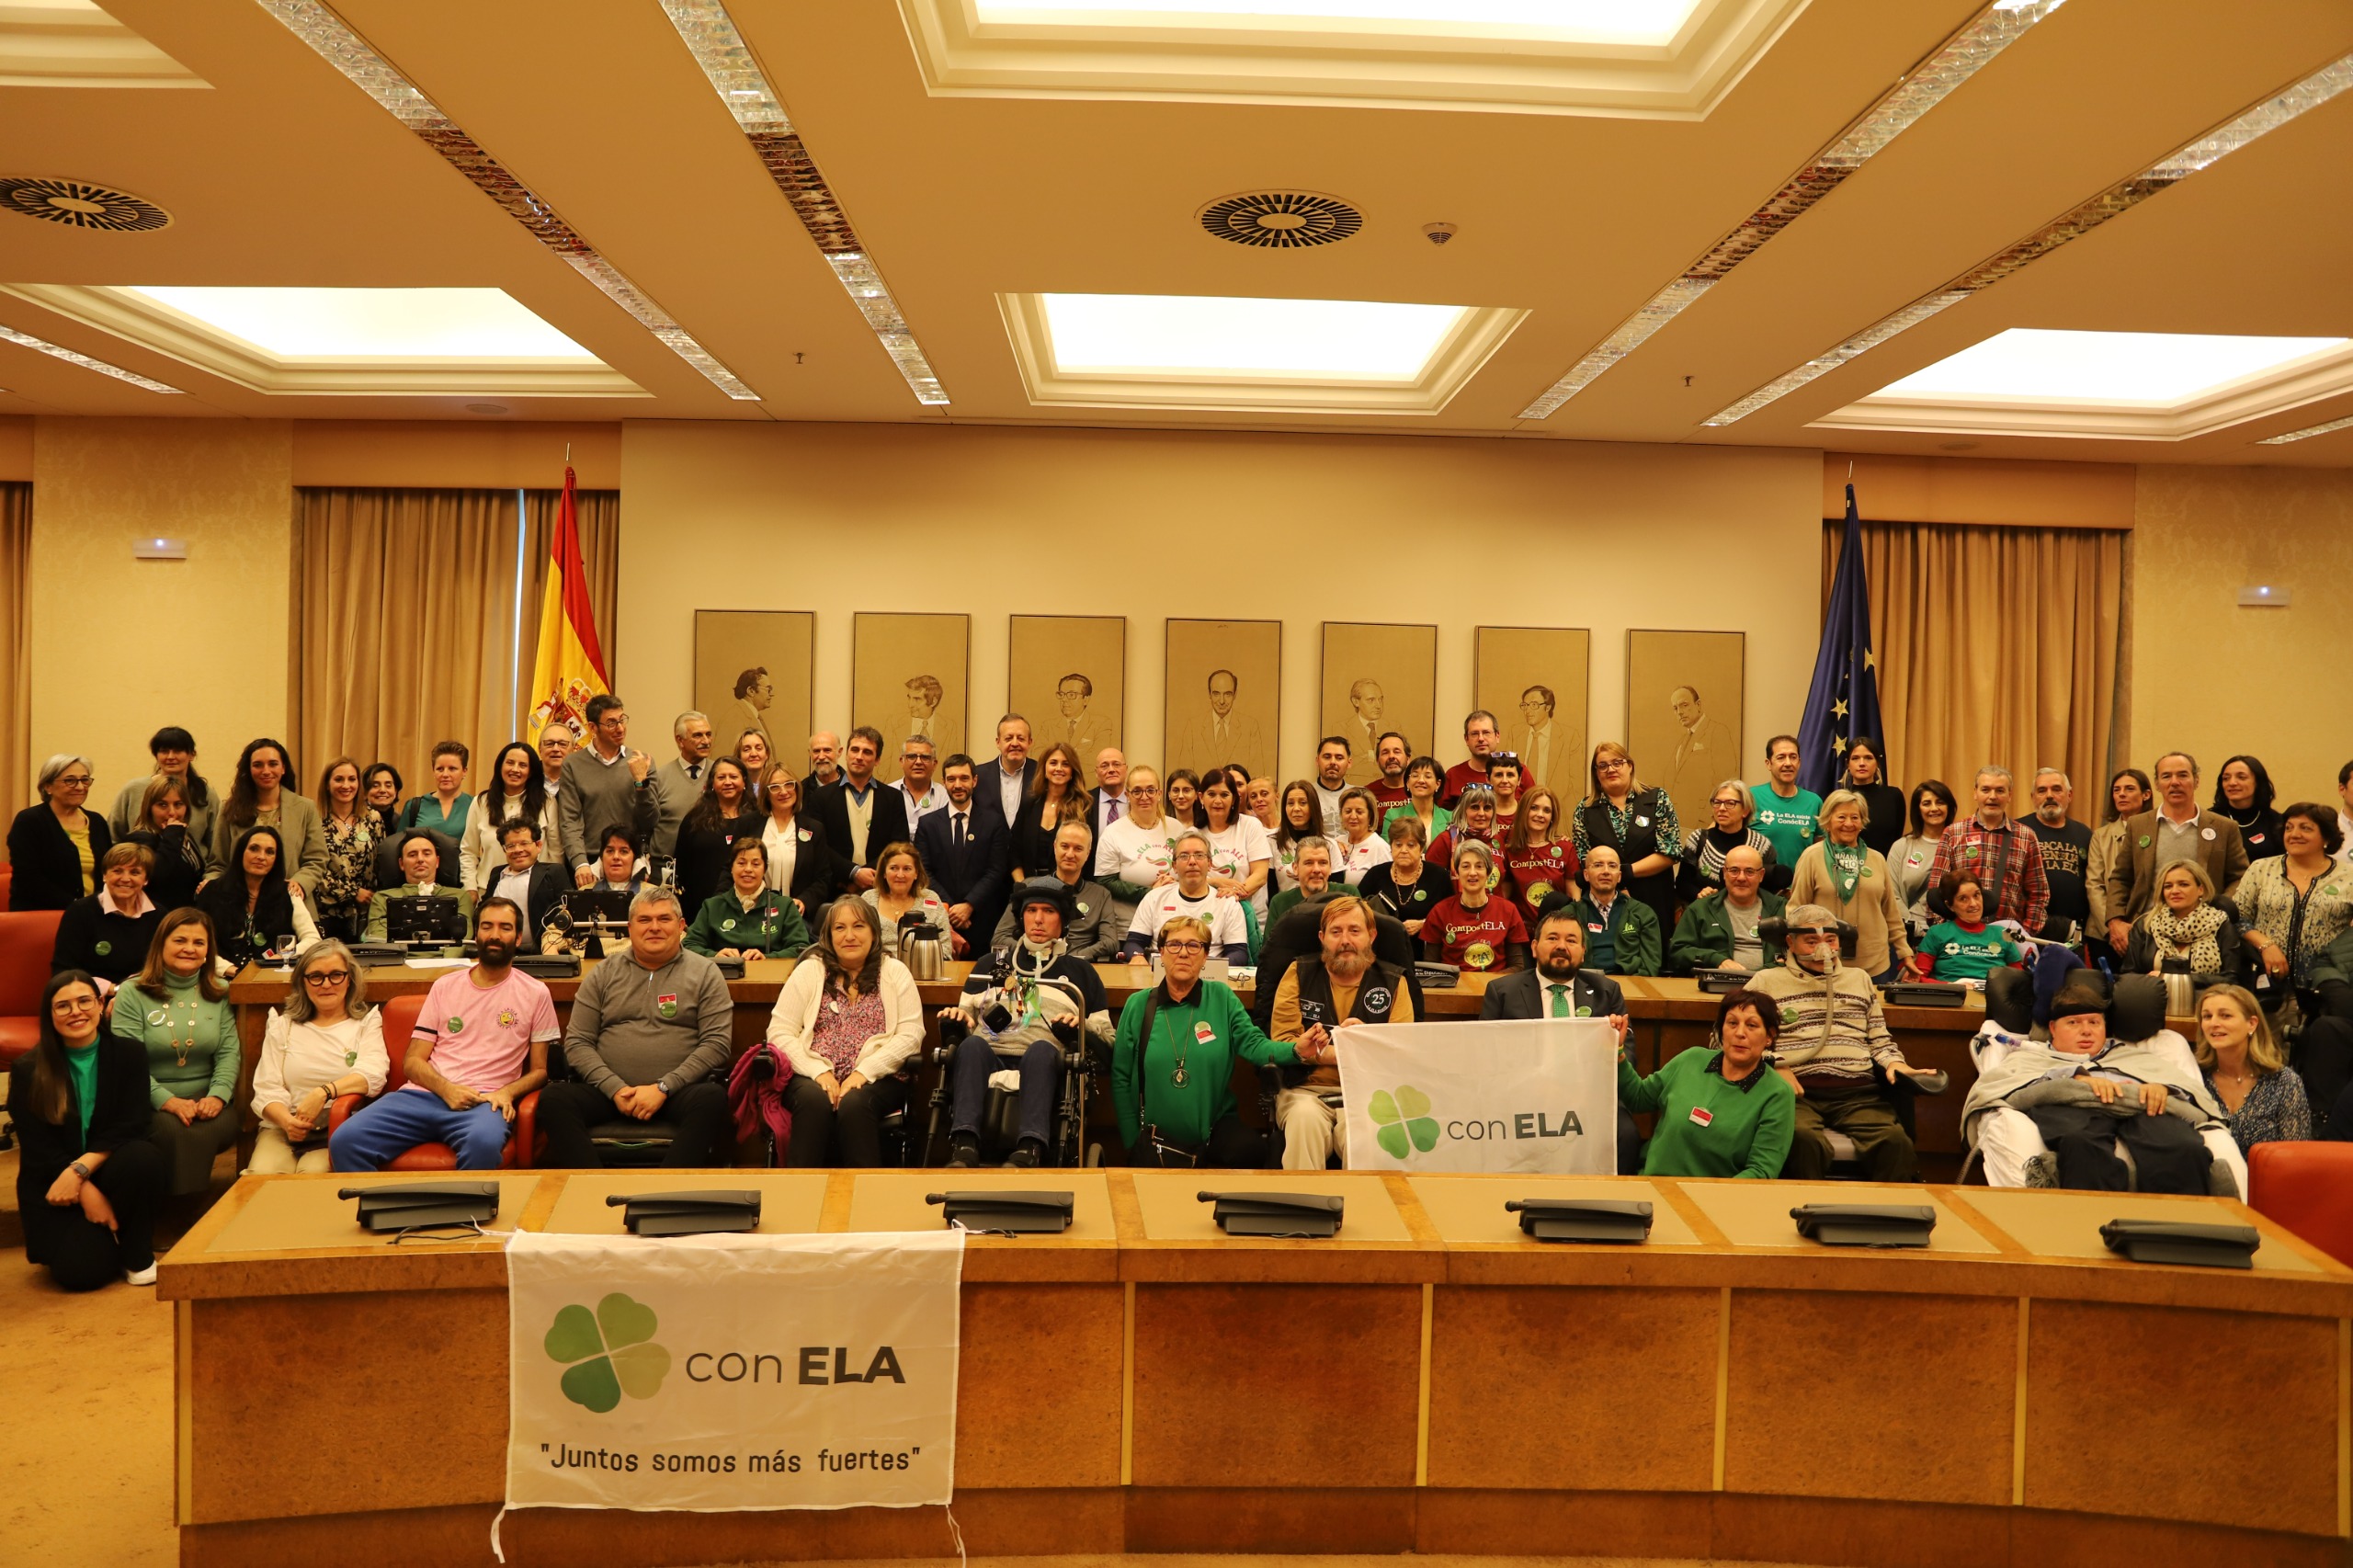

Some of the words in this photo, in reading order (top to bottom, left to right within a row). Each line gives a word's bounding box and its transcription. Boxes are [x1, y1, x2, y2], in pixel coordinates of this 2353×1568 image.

[1777, 818, 1810, 826] ConócELA
[1230, 847, 1245, 861] ALE
[2042, 850, 2078, 864] ENGUA
[1510, 858, 1564, 869] CompostELA
[2045, 860, 2060, 870] LA
[1445, 921, 1506, 935] CompostELA
[1371, 994, 1385, 1005] 25
[1448, 1120, 1506, 1140] con
[1515, 1111, 1583, 1139] ELA
[687, 1353, 781, 1383] con
[799, 1346, 905, 1385] ELA
[541, 1444, 638, 1471] "Juntos
[653, 1454, 735, 1473] somos
[749, 1449, 801, 1472] más
[818, 1448, 920, 1471] fuertes"
